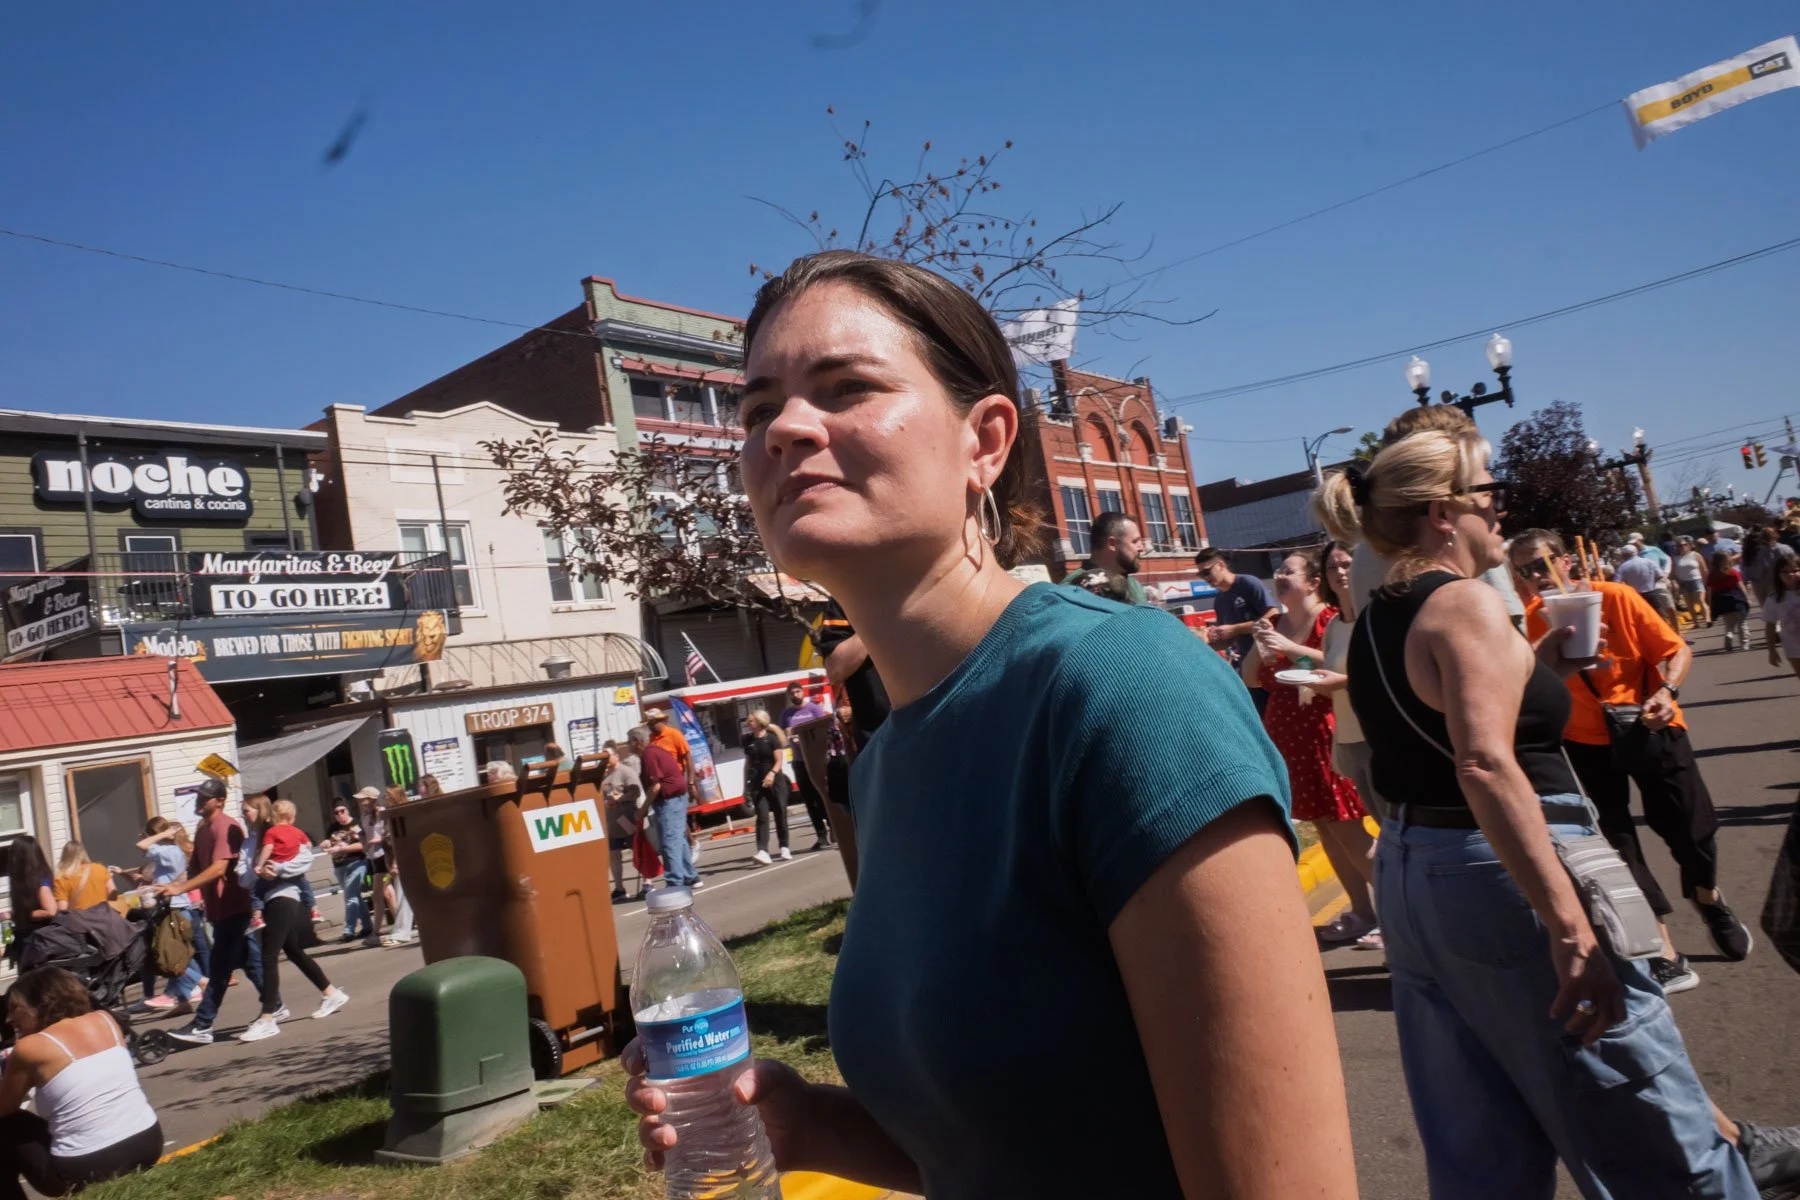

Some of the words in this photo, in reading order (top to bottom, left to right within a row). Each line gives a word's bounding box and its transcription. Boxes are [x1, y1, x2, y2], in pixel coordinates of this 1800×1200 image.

[1670, 84, 1713, 109] BOYD
[1753, 57, 1786, 75] CAT
[45, 456, 245, 497] noche
[144, 498, 191, 510] cantina
[194, 499, 205, 510] &
[208, 499, 246, 511] cocina
[199, 553, 322, 584] Margaritas
[327, 554, 345, 575] &
[345, 554, 395, 575] Beer
[314, 586, 384, 607] HERE!
[142, 635, 198, 657] Modelo
[212, 636, 259, 657] BREWED
[259, 635, 280, 654] FOR
[281, 633, 313, 652] THOSE
[314, 632, 340, 651] WITH
[341, 629, 385, 649] FIGHTING
[470, 709, 519, 730] TROOP
[522, 705, 550, 725] 374
[534, 810, 592, 840] WM
[666, 1036, 704, 1053] Purified
[704, 1030, 730, 1046] Water
[682, 1025, 694, 1034] Pur
